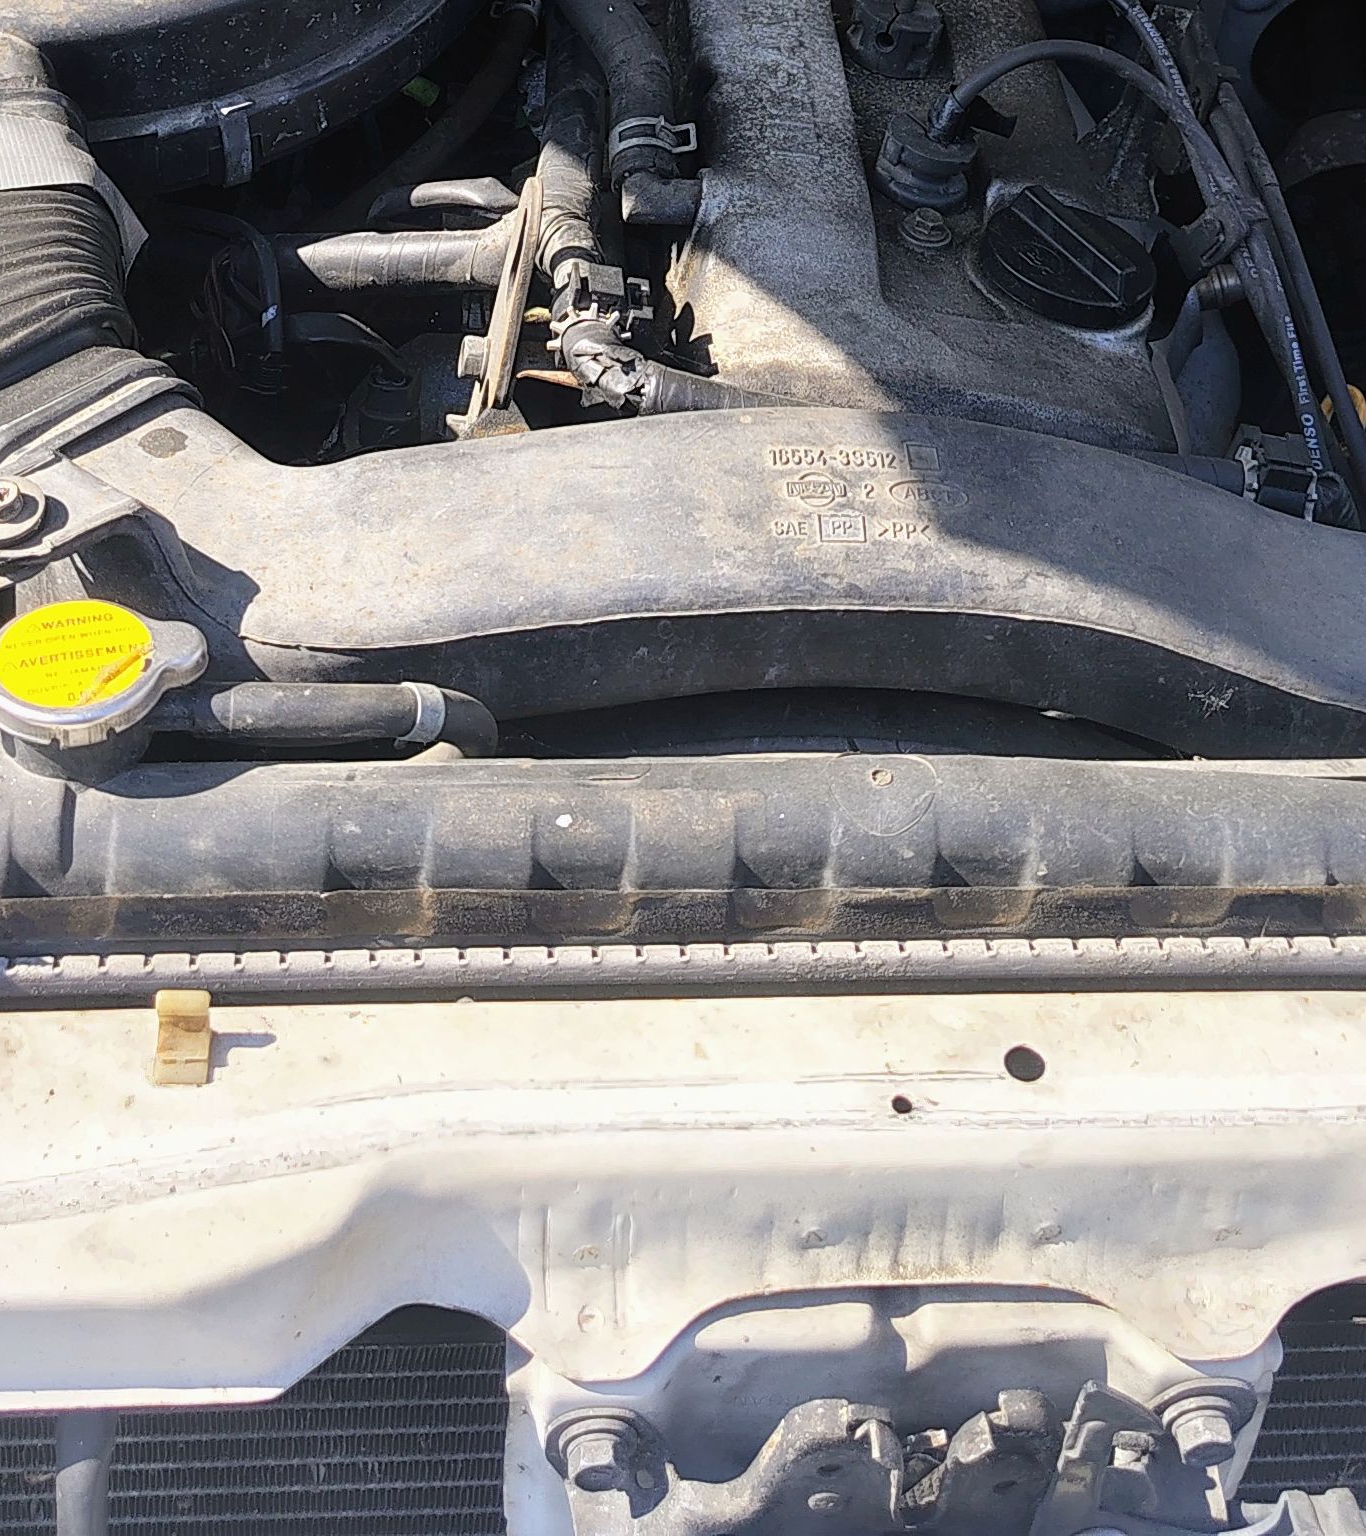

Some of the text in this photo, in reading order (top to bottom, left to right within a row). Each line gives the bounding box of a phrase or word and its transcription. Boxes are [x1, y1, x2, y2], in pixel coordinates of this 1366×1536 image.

[1291, 341, 1304, 375] Time
[1297, 374, 1311, 406] First
[1300, 413, 1324, 471] DENSO
[862, 483, 875, 500] 2
[774, 520, 808, 537] SAE
[831, 520, 853, 535] PP
[41, 612, 114, 631] WARNING
[5, 638, 42, 650] NEVER
[45, 632, 76, 643] OPEN
[80, 628, 112, 638] WHEN
